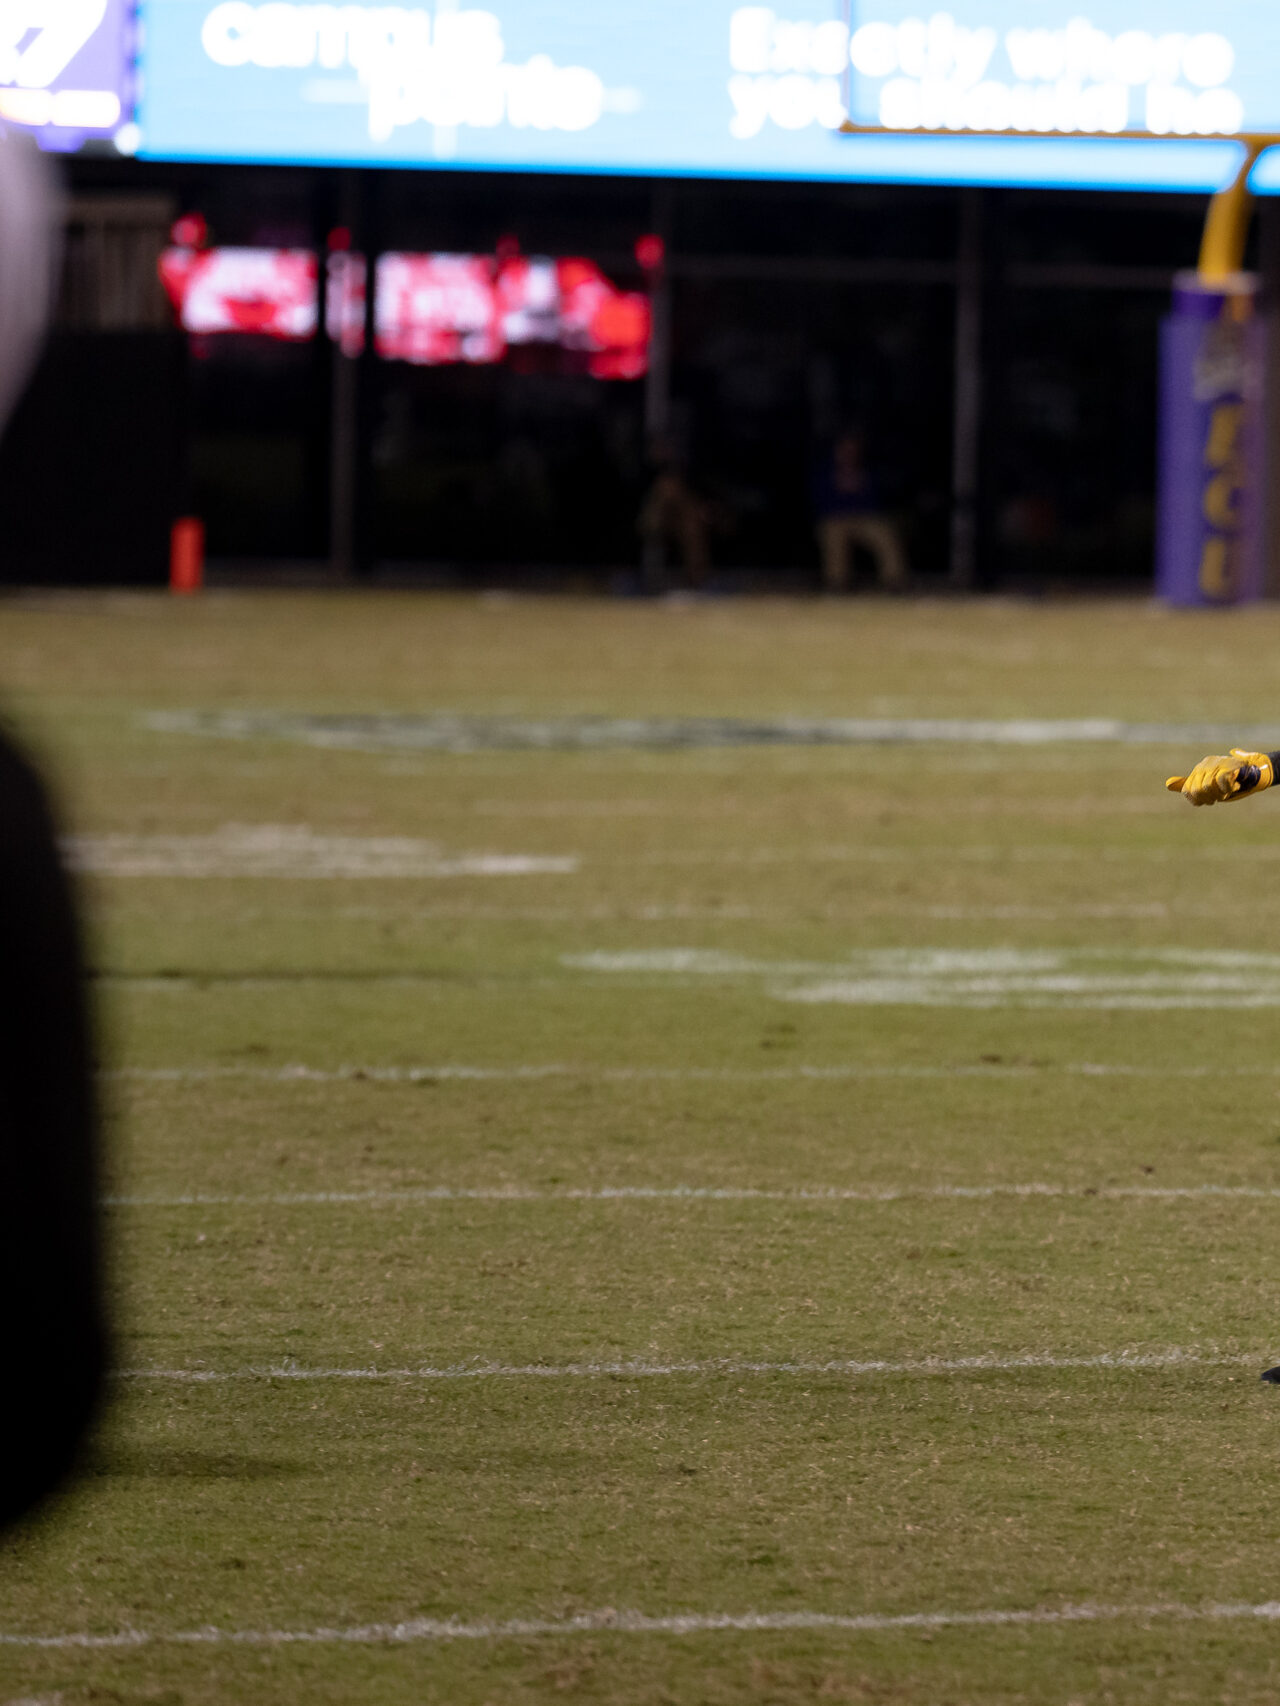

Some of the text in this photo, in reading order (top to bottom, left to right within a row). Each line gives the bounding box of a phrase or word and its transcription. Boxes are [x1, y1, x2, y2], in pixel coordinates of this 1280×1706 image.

[731, 8, 1235, 87] Exactly where
[728, 75, 1244, 138] you should be
